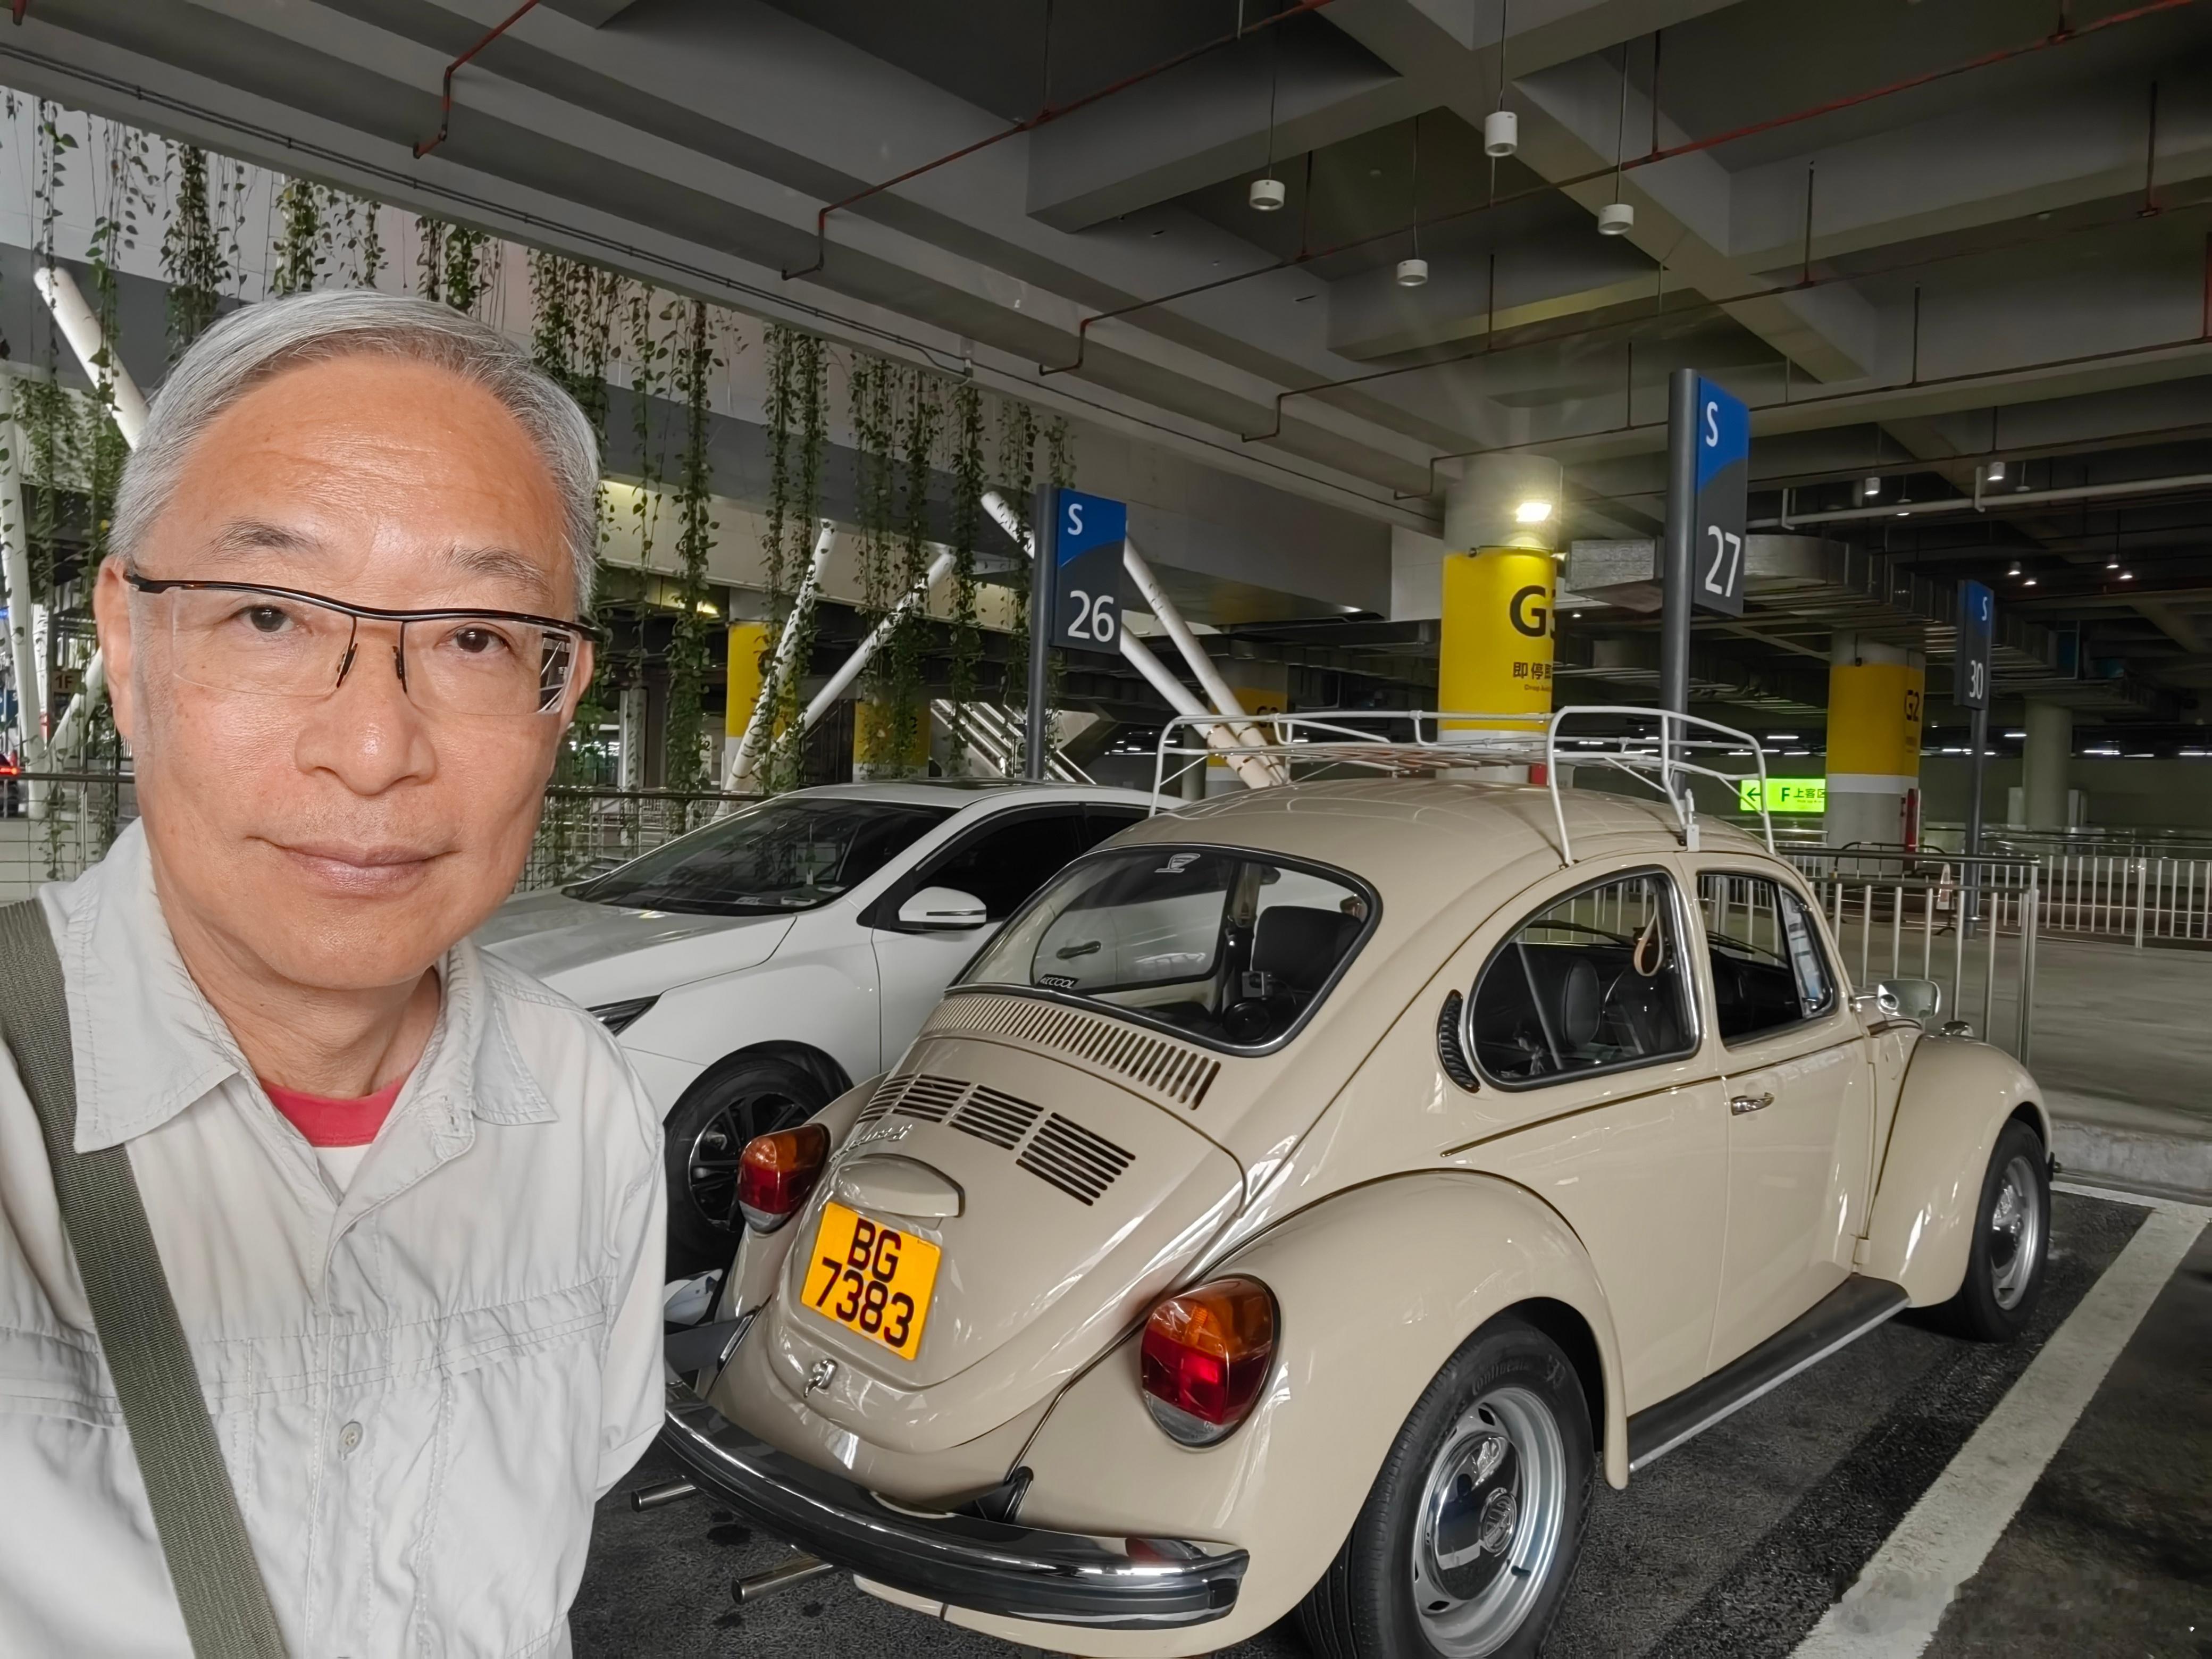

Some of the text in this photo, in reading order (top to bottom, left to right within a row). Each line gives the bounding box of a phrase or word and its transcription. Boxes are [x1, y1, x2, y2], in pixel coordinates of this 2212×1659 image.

[1706, 401, 1718, 447] S
[1067, 503, 1083, 535] S
[1705, 525, 1741, 598] 27
[1068, 590, 1115, 642] 26
[1510, 585, 1556, 639] G
[1982, 596, 1988, 621] S
[55, 675, 73, 690] 1F
[1970, 660, 1983, 700] 30
[1904, 690, 1920, 722] G2
[1782, 787, 1790, 802] F
[847, 1218, 901, 1283] BG
[816, 1256, 915, 1348] 7383
